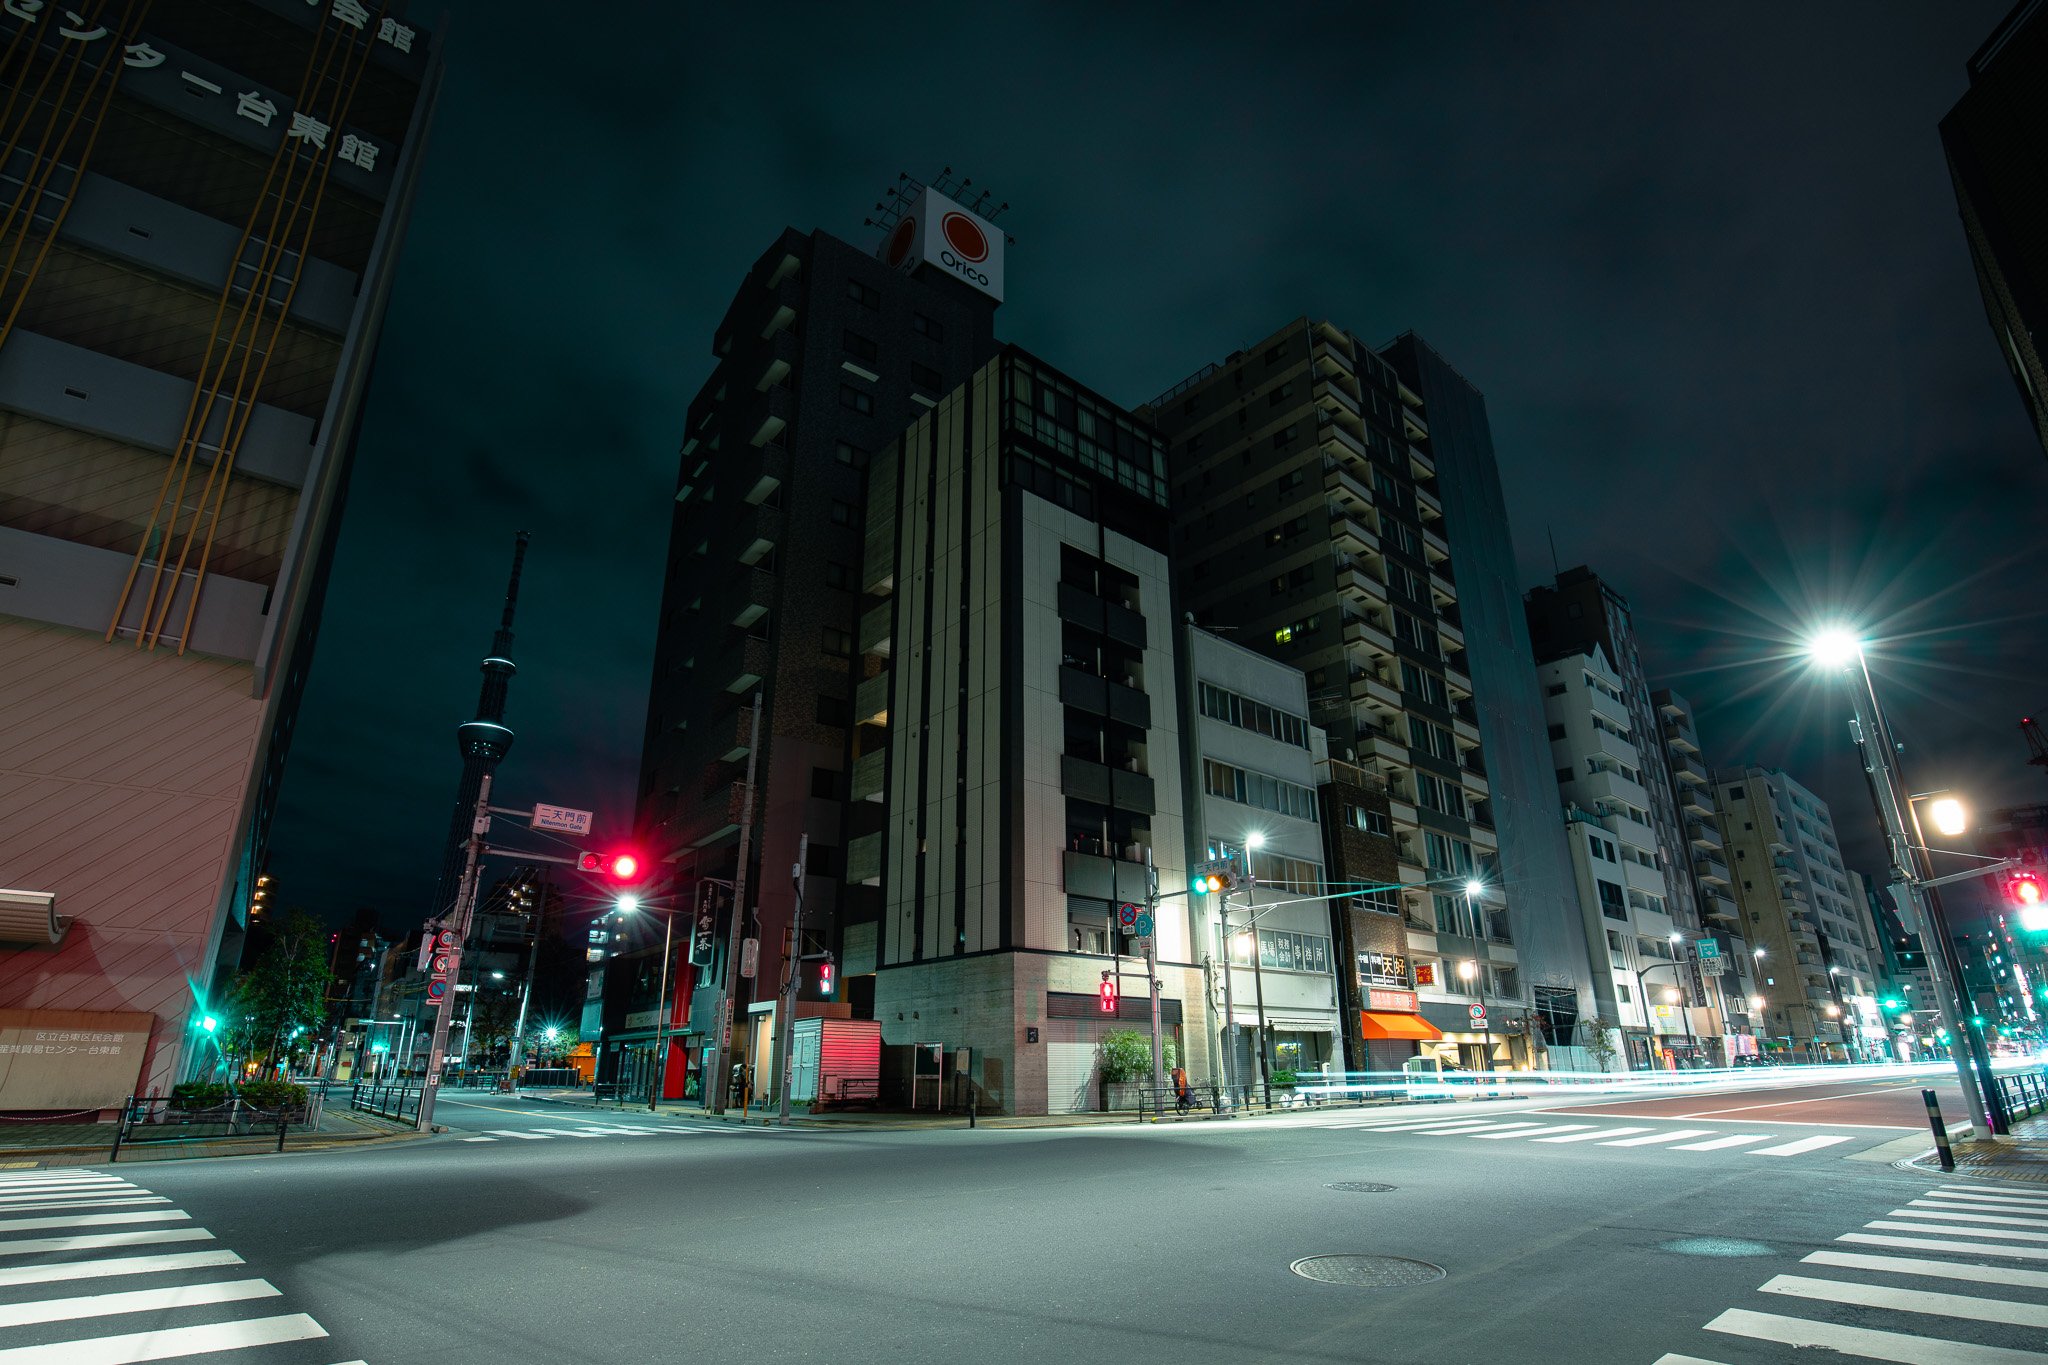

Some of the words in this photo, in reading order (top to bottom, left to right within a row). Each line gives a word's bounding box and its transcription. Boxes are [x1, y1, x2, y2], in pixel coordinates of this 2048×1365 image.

[306, 0, 416, 54] 会館
[941, 251, 988, 286] Orico
[540, 808, 587, 824] 二天門前
[541, 819, 568, 828] Nitenmon
[570, 823, 583, 831] Gate
